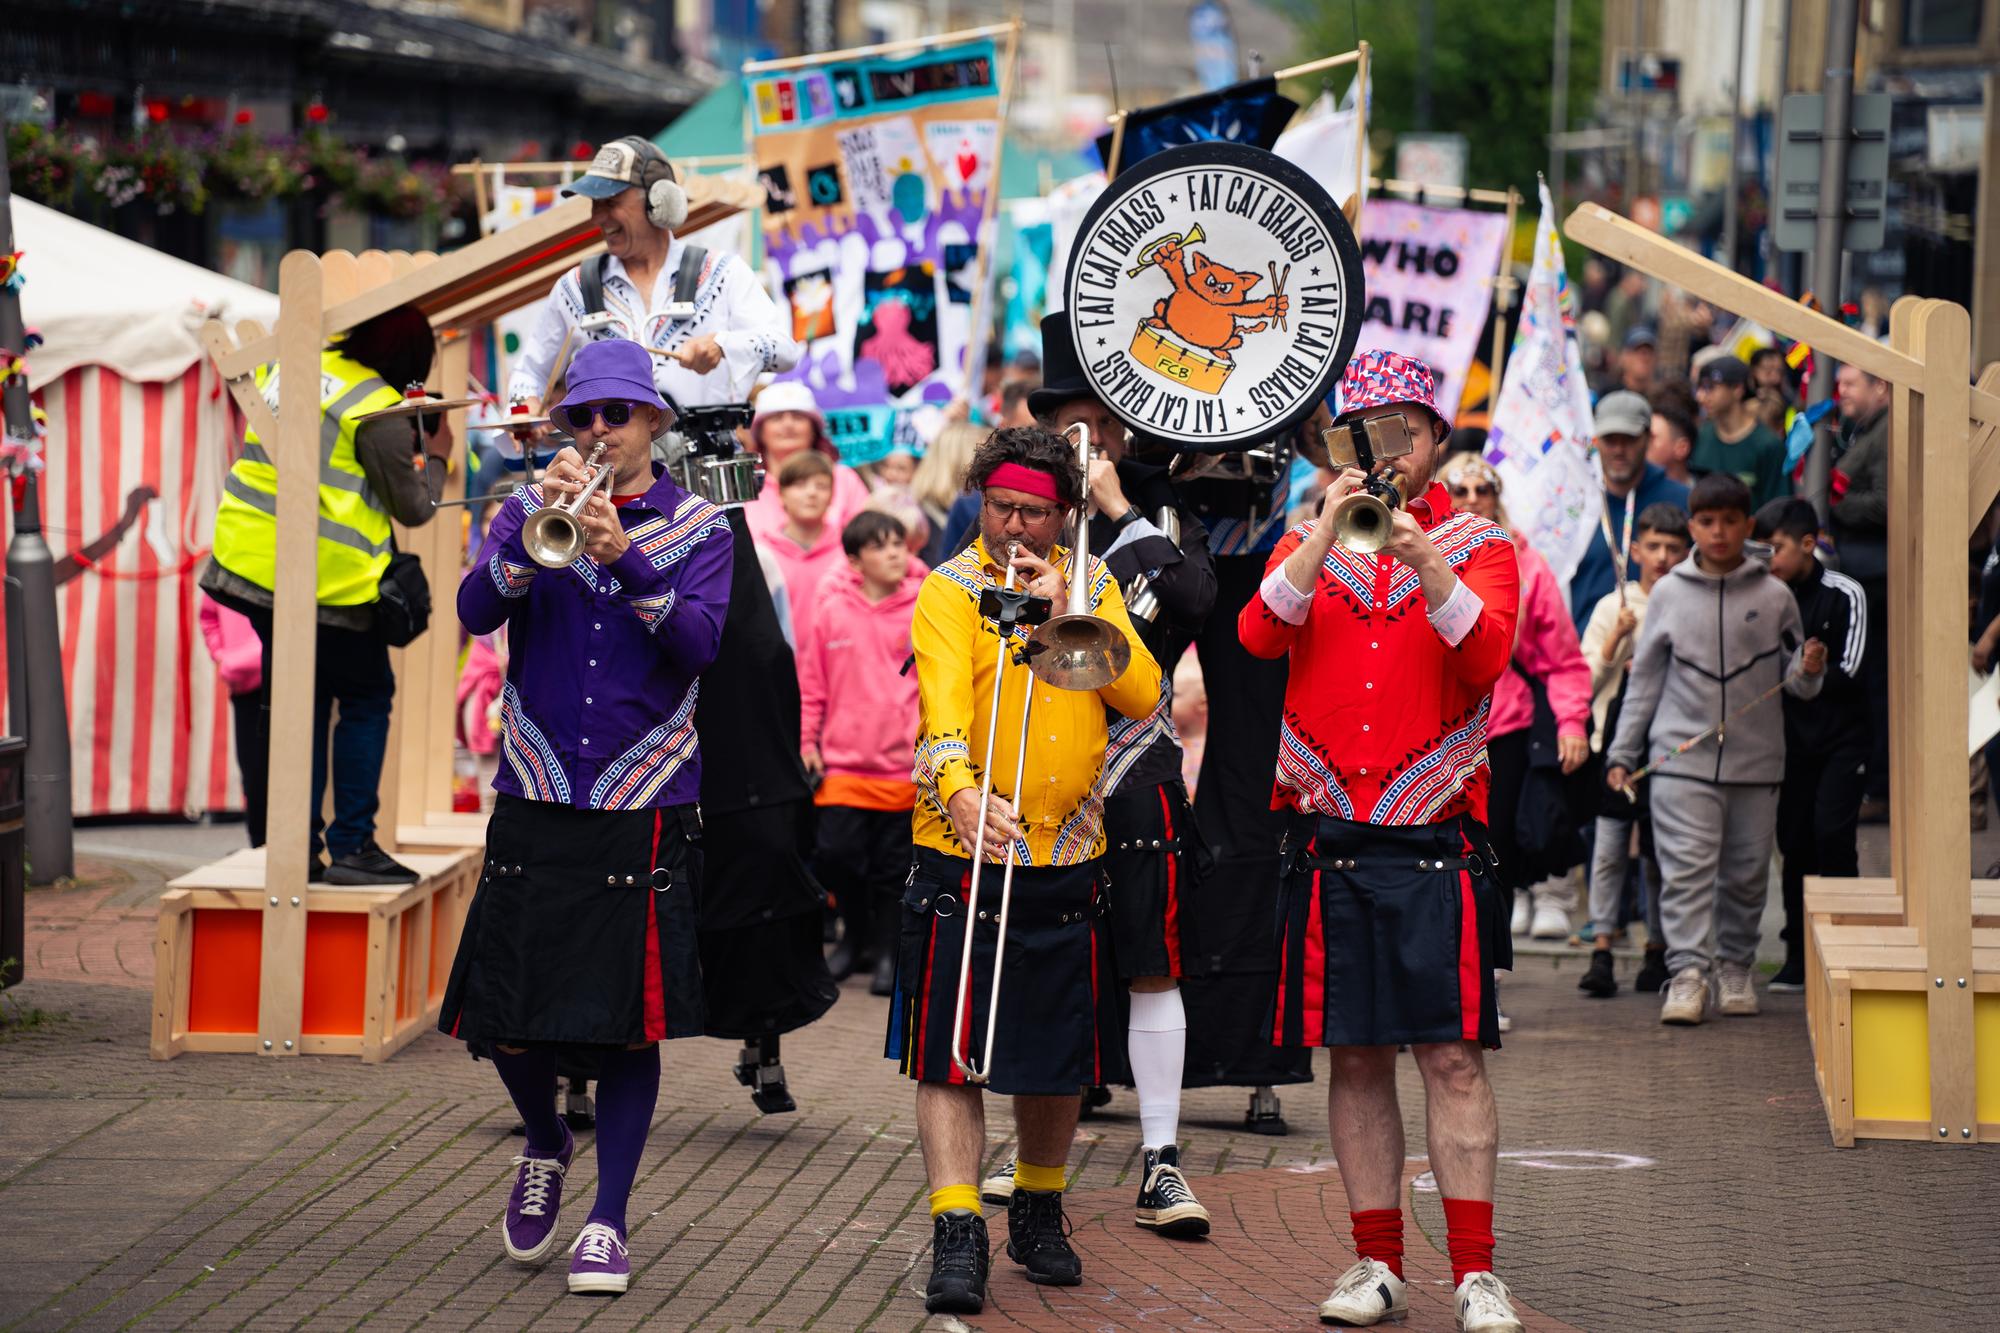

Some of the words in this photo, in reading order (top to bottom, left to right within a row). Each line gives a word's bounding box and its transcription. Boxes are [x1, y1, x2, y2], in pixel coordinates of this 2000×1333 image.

[1100, 189, 1165, 256] BRASS
[1187, 173, 1223, 212] FAT
[1225, 176, 1269, 219] CAT
[1258, 194, 1325, 263] BRASS
[1080, 246, 1123, 290] CAT
[1361, 238, 1458, 277] WHO
[1079, 291, 1115, 328] FAT
[1301, 282, 1338, 318] FAT
[1364, 297, 1454, 338] ARE
[1292, 321, 1334, 363] CAT
[1092, 350, 1157, 416] BRASS
[1158, 358, 1190, 379] FCB
[1248, 354, 1316, 419] BRASS
[1147, 391, 1189, 431] CAT
[1193, 398, 1228, 433] FAT
